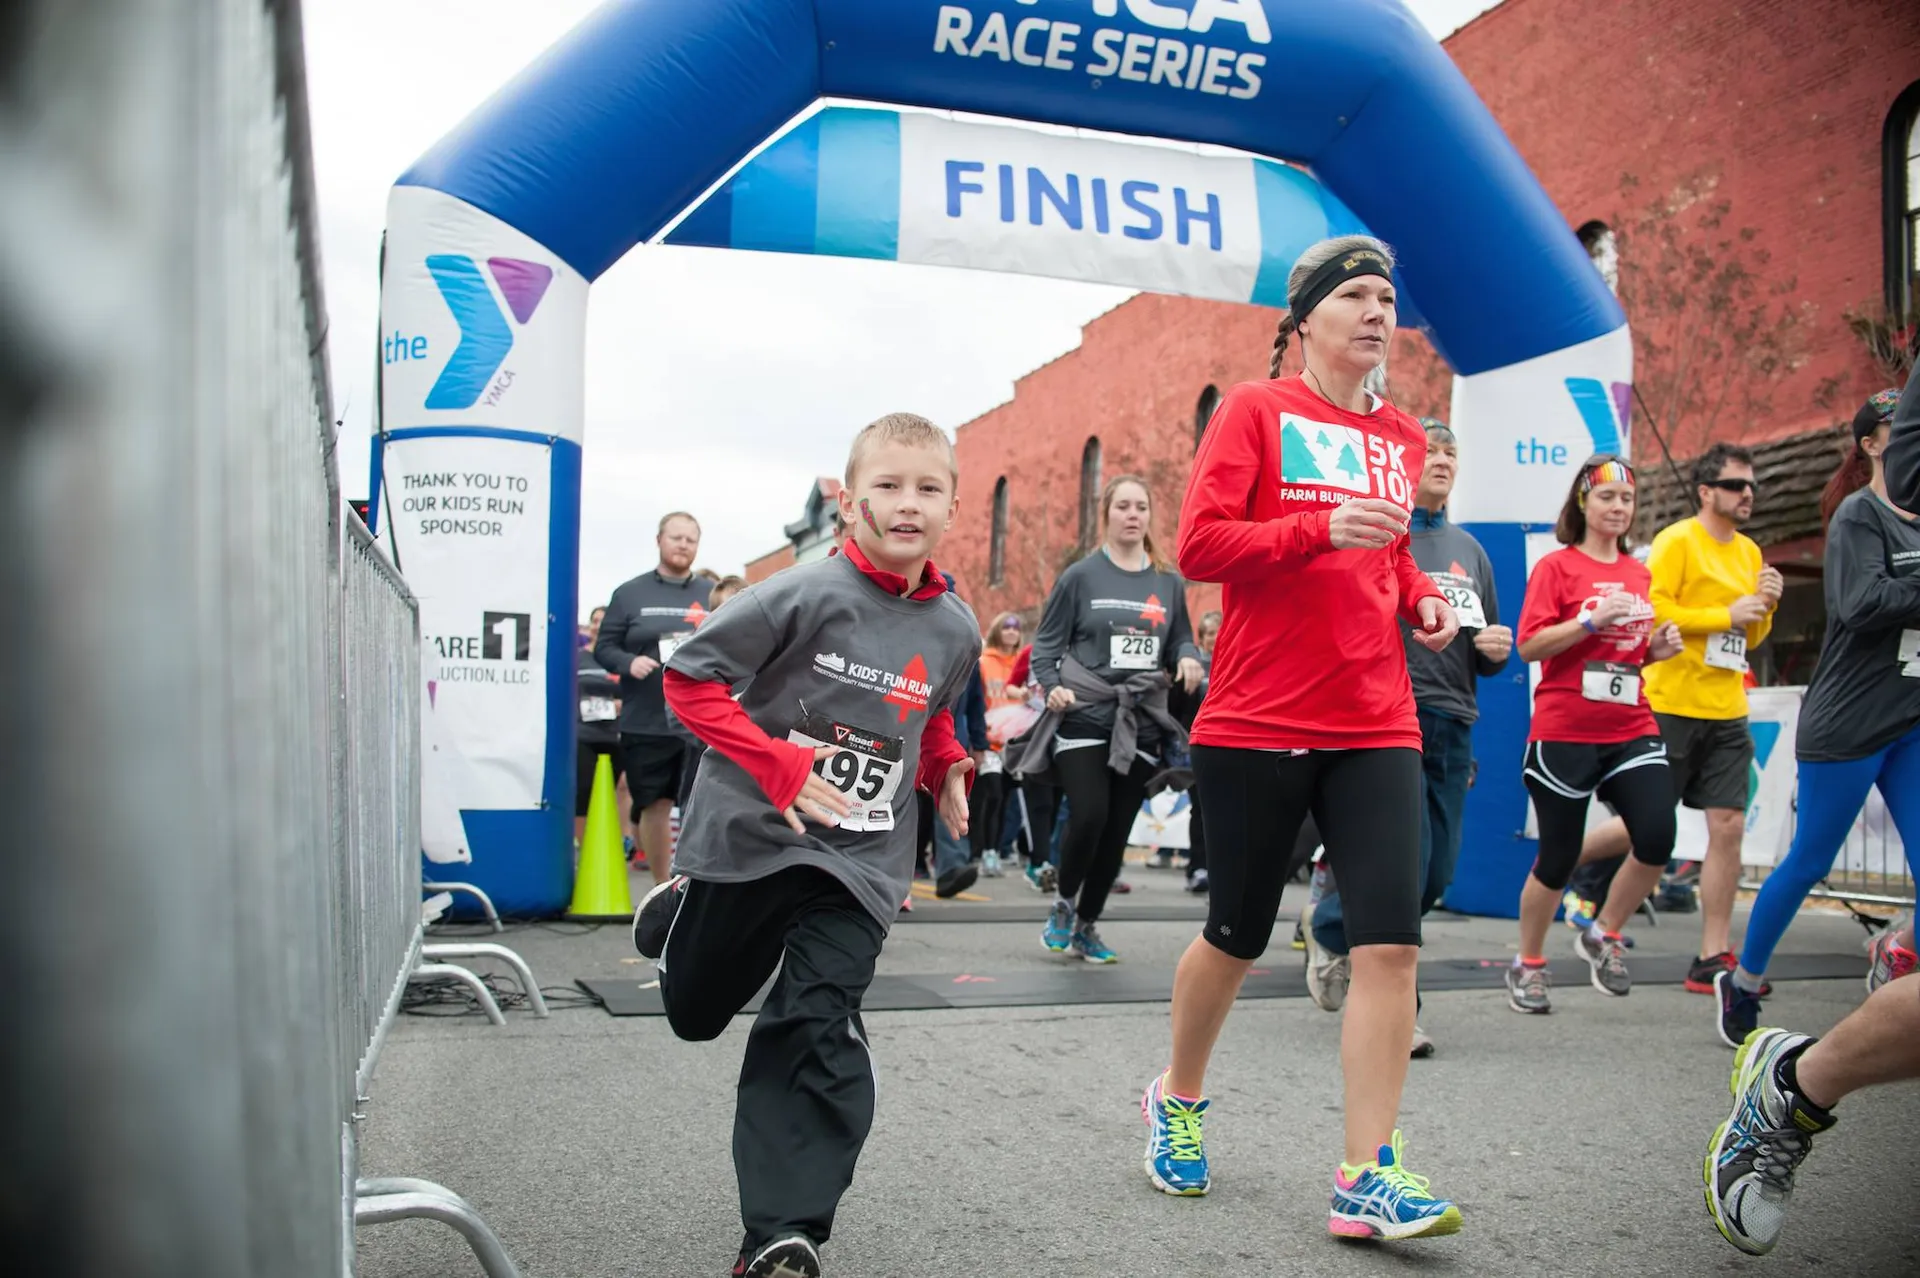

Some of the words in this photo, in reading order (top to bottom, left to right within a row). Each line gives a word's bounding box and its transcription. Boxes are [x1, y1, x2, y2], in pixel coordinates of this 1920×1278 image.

[933, 5, 1081, 70] RACE
[1086, 28, 1267, 99] SERIES
[945, 160, 1222, 251] FINISH
[385, 331, 428, 364] the
[483, 369, 516, 408] YMCA
[1368, 433, 1407, 477] 5K
[1515, 437, 1568, 466] the
[402, 472, 458, 490] THANK
[462, 473, 501, 489] YOU
[505, 476, 528, 492] TO
[402, 496, 437, 513] OUR
[442, 496, 482, 511] KIDS
[487, 498, 524, 515] RUN
[1280, 488, 1317, 502] FARM
[1320, 490, 1357, 505] BURE
[420, 519, 503, 536] SPONSOR
[1122, 637, 1154, 655] 278
[1721, 635, 1743, 656] 211
[437, 666, 499, 685] UCTION,
[503, 668, 530, 684] LLC
[848, 662, 882, 683] KIDS'
[882, 671, 908, 691] FUN
[907, 679, 933, 697] RUN
[1609, 676, 1624, 696] 6
